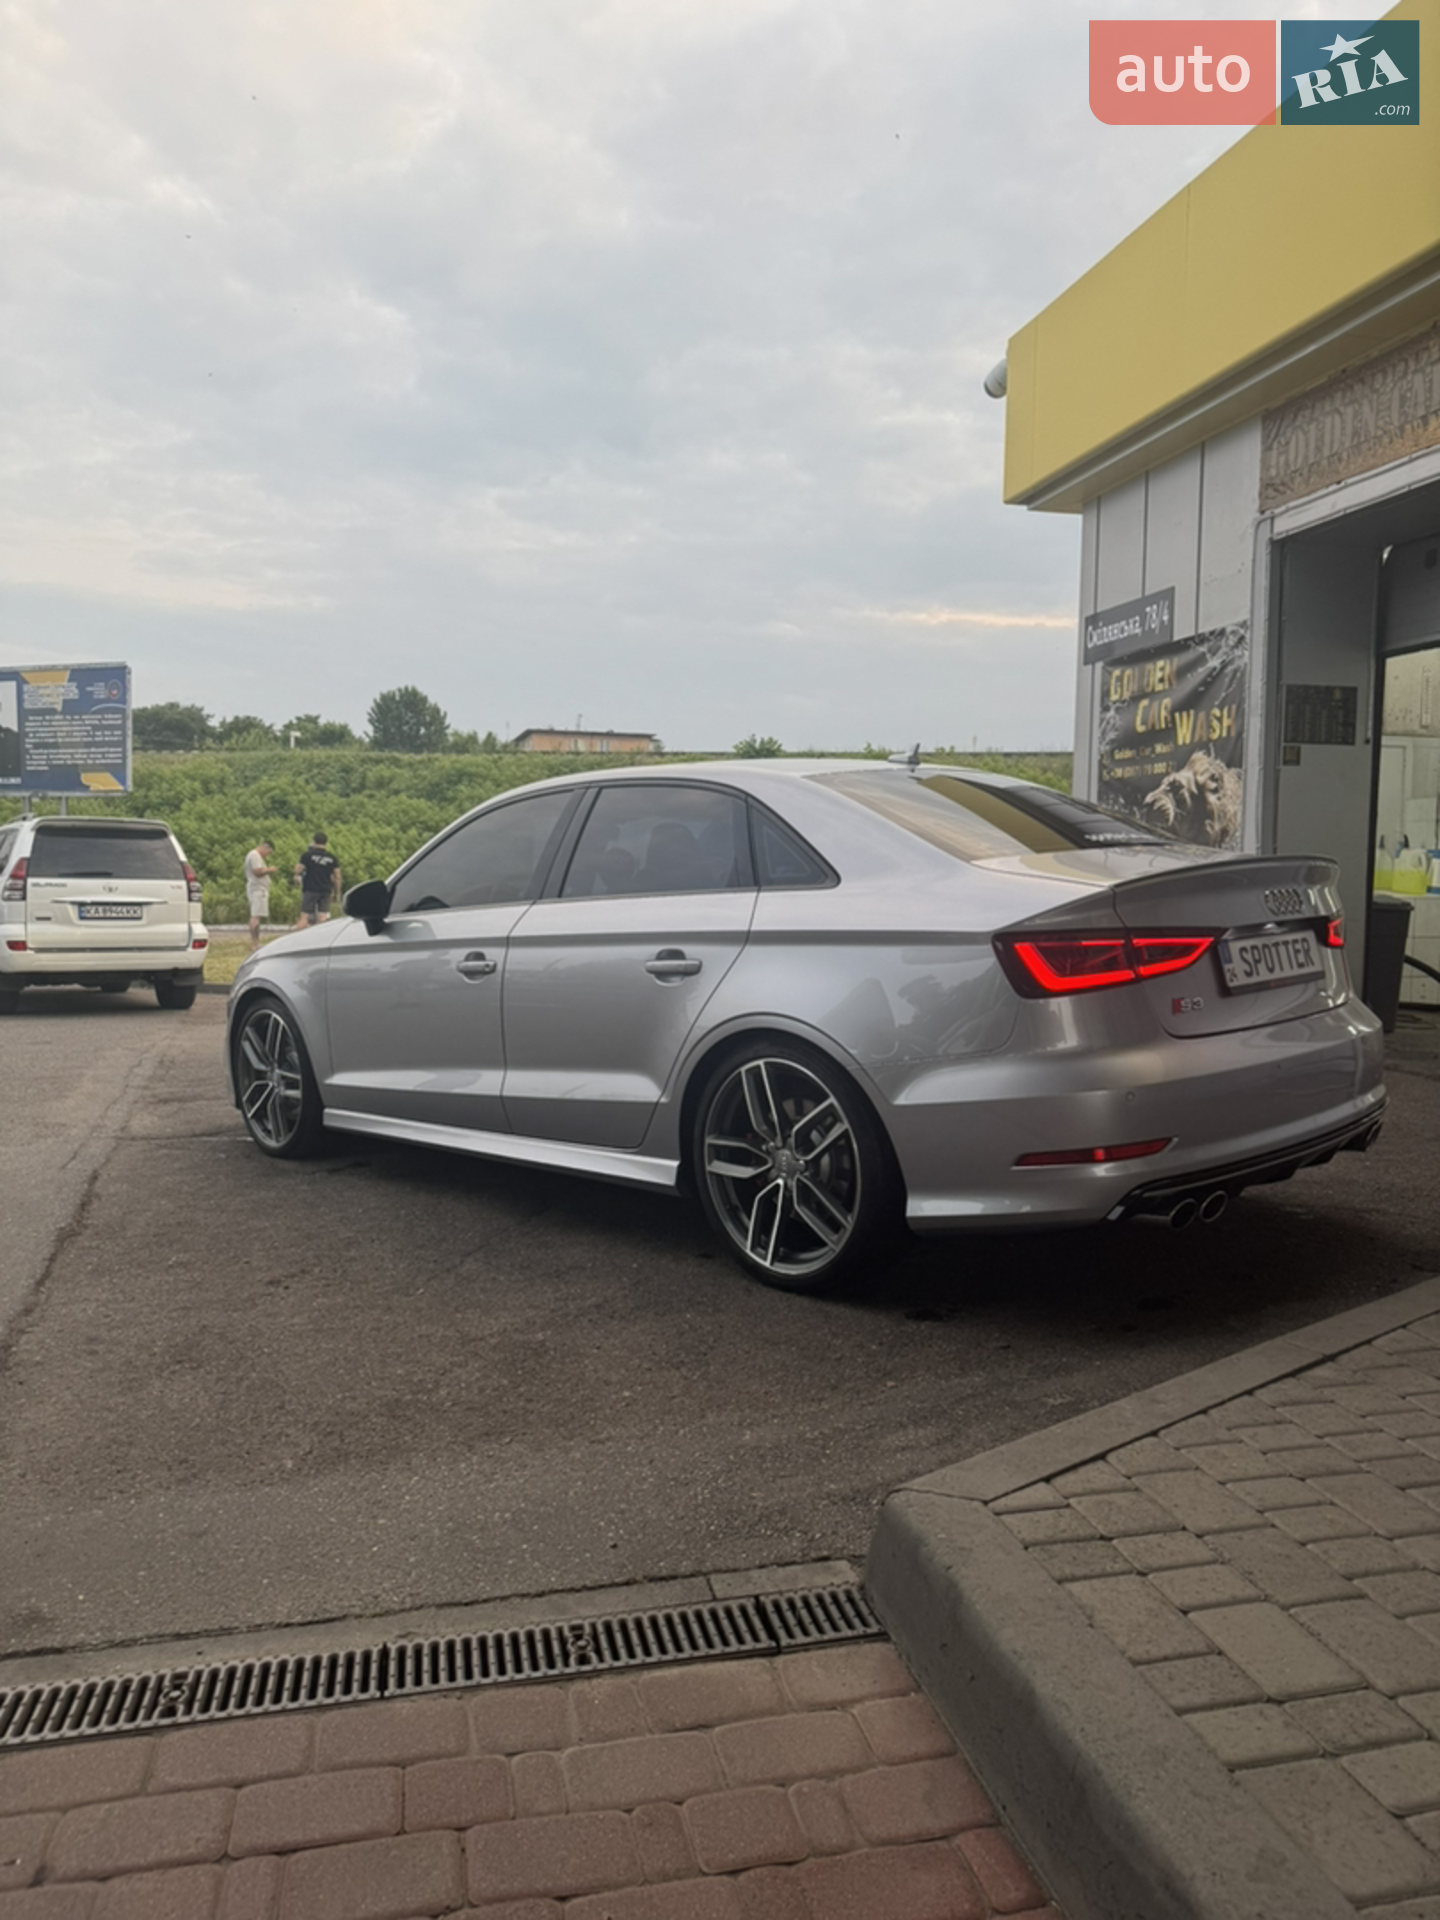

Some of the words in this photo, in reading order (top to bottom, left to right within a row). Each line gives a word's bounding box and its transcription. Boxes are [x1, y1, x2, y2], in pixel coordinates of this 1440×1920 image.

[1109, 659, 1177, 701] GOLDEN
[1135, 696, 1172, 734] CAR
[1174, 704, 1236, 746] WASH
[1238, 936, 1315, 978] SPOTTER
